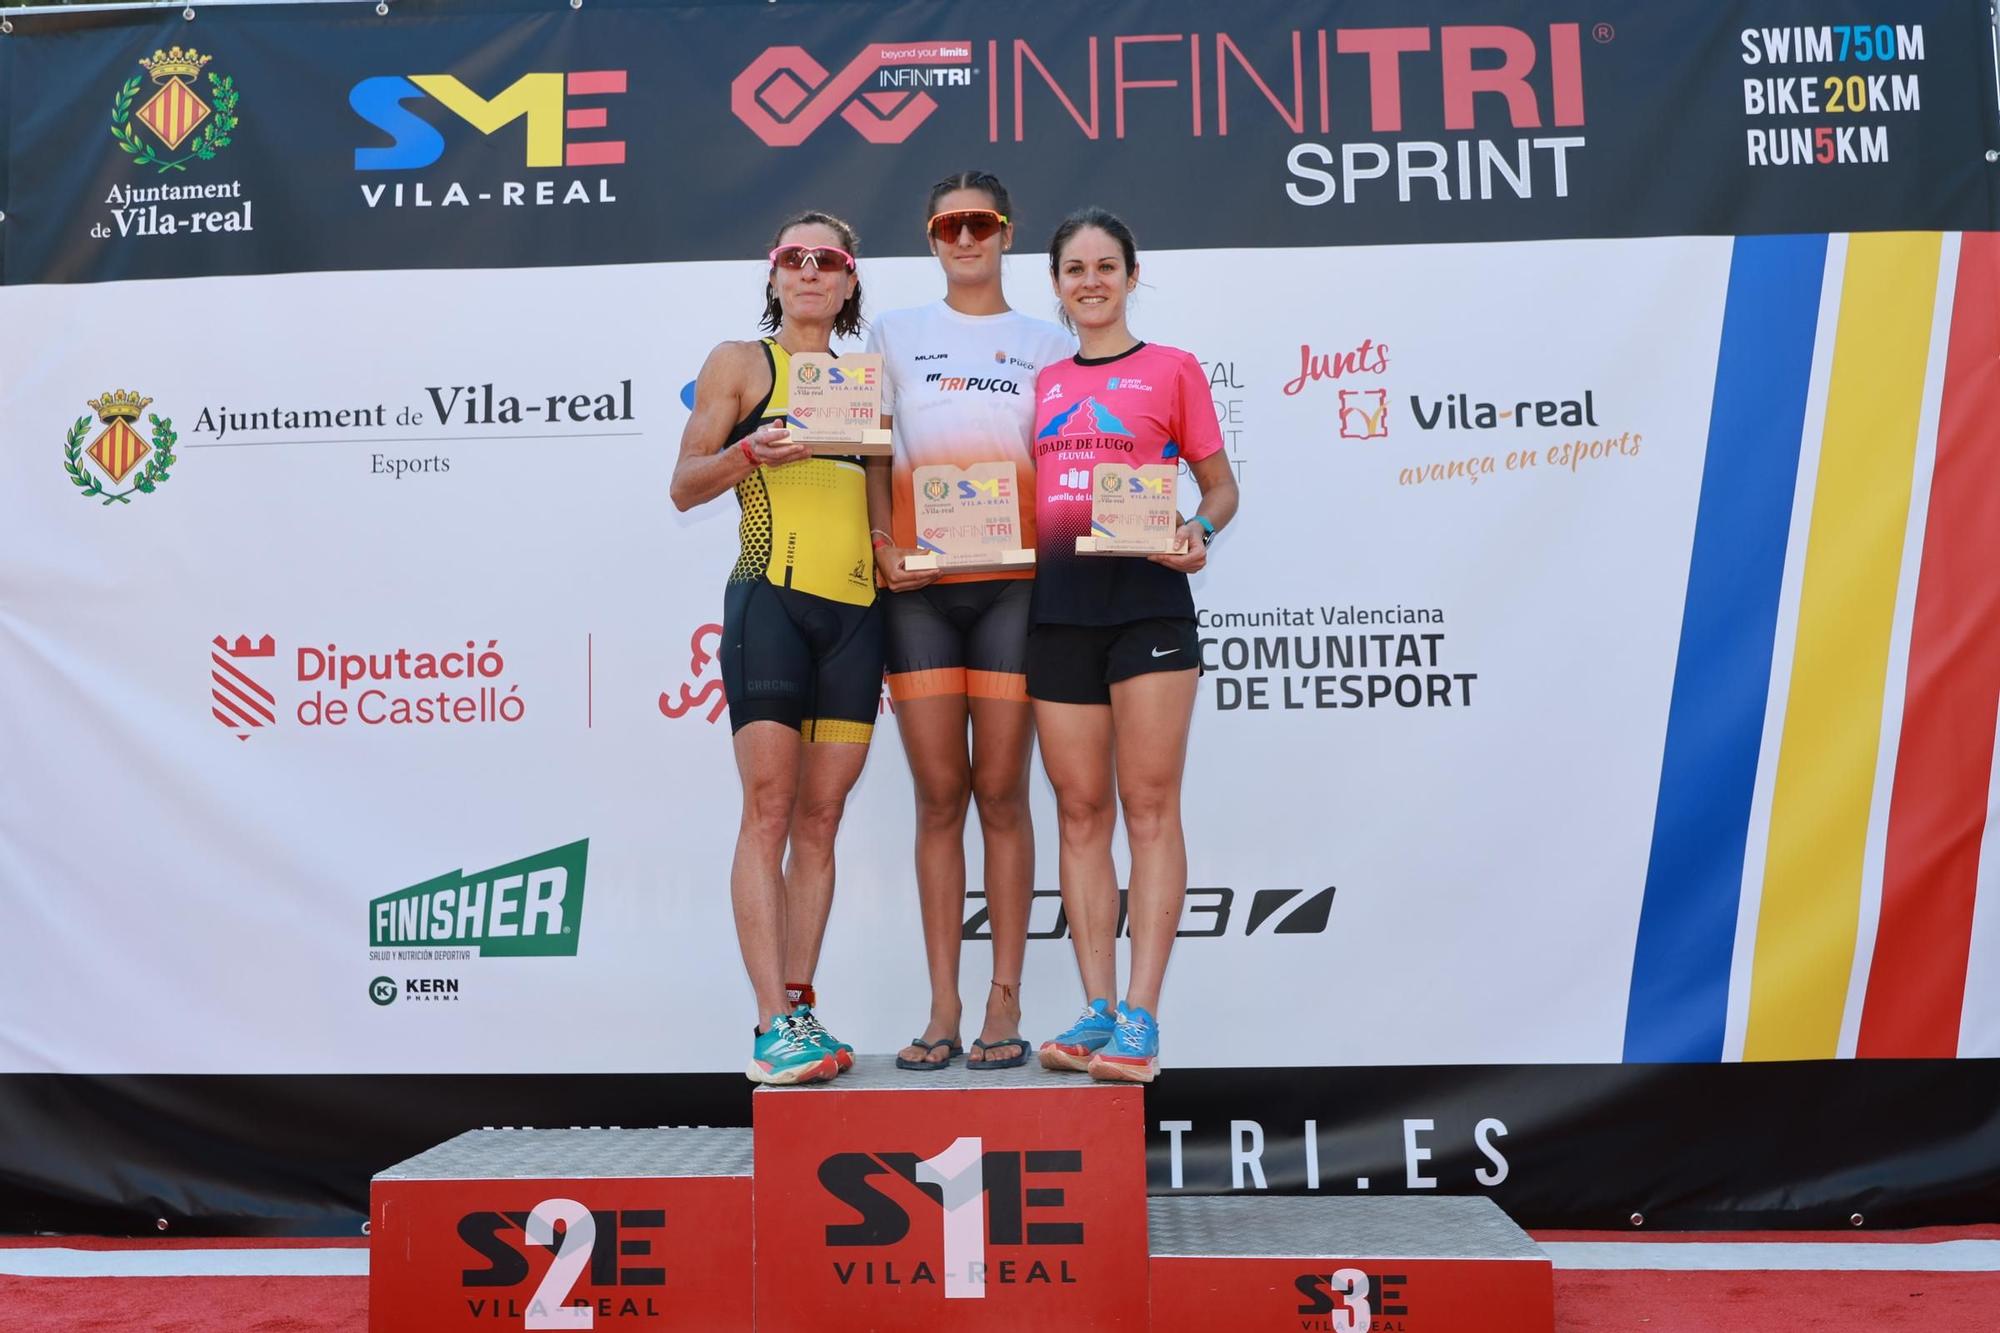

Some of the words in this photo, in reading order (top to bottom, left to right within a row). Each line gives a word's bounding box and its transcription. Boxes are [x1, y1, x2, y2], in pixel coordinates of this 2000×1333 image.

[881, 49, 916, 59] beyond
[918, 49, 937, 58] your
[940, 48, 969, 57] limits
[880, 68, 971, 87] INFINITRI
[988, 22, 1585, 142] INFINITRI
[349, 70, 628, 171] SME
[1285, 136, 1586, 206] SPRINT
[105, 179, 242, 207] Ajuntament
[361, 178, 617, 208] VILA-REAL
[91, 223, 112, 239] de
[114, 202, 254, 236] Vila-real
[828, 367, 876, 385] SME
[1284, 338, 1390, 396] Junts
[939, 377, 1020, 396] TRIPUÇOL
[192, 402, 388, 440] Ajuntament
[395, 406, 424, 427] de
[425, 379, 636, 427] Vila-real
[1409, 390, 1600, 430] Vila-real
[1058, 451, 1095, 461] FLUVIAL
[1075, 440, 1092, 450] DE
[1096, 438, 1134, 453] LUGO
[1399, 457, 1496, 486] avança
[1505, 449, 1538, 471] en
[1546, 430, 1643, 473] esports
[370, 454, 451, 480] Esports
[1128, 477, 1172, 493] SME
[957, 479, 1010, 499] SME
[1075, 493, 1085, 501] de
[1197, 609, 1315, 628] Comunitat
[1320, 604, 1445, 626] Valenciana
[297, 640, 504, 689] Diputació
[1198, 634, 1445, 672] COMUNITAT
[297, 690, 348, 726] de
[357, 685, 525, 725] Castelló
[1216, 677, 1270, 711] DE
[1283, 673, 1478, 710] L'ESPORT
[376, 866, 568, 942] FINISHER
[369, 951, 391, 961] SALUD
[434, 950, 470, 961] DEPORTIVA
[406, 979, 459, 993] KERN
[915, 1136, 986, 1299] 1
[524, 1198, 594, 1330] 2
[1330, 1268, 1371, 1333] 3
